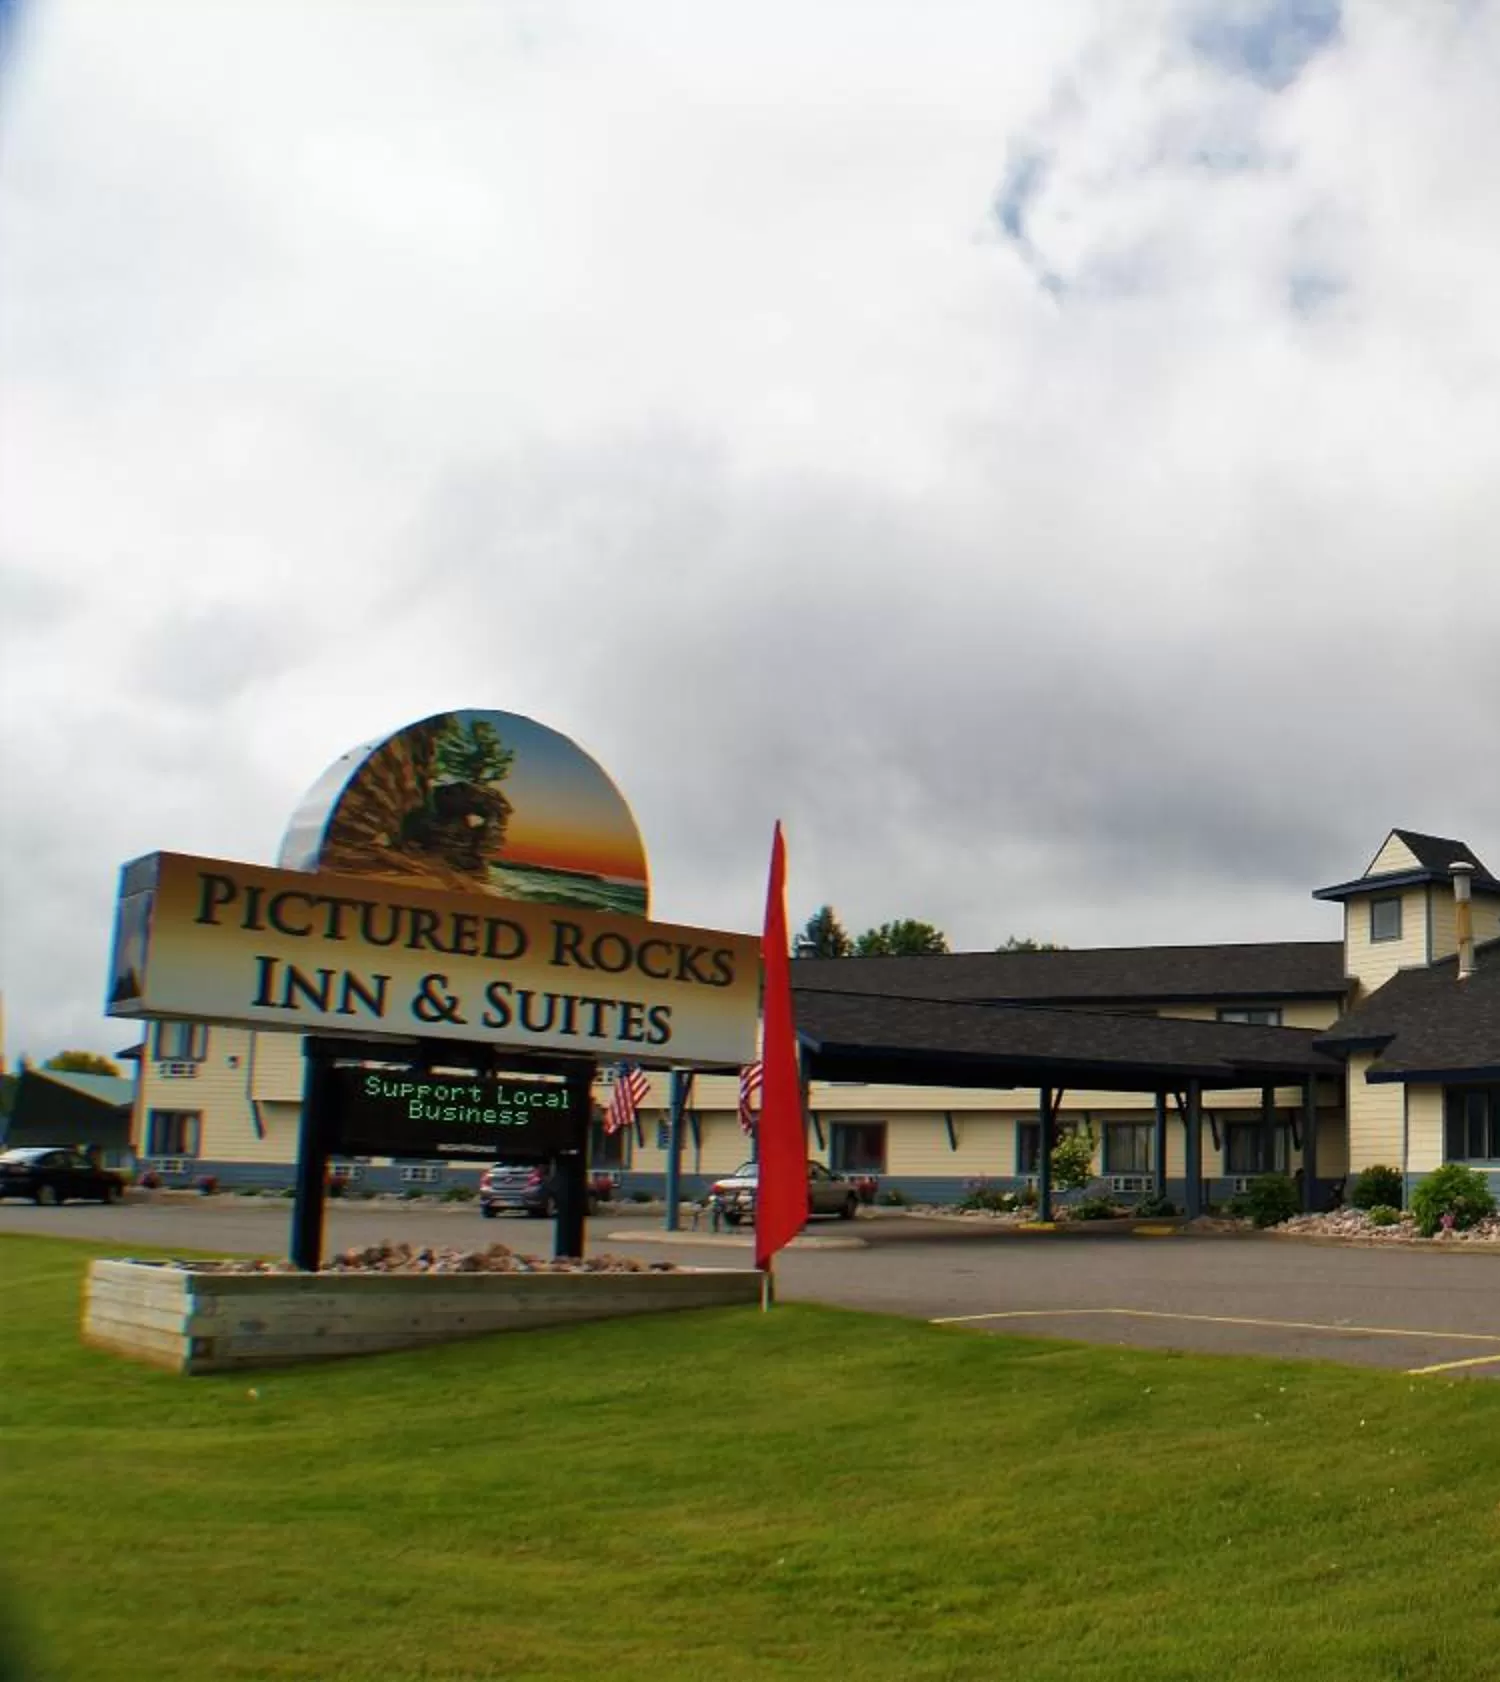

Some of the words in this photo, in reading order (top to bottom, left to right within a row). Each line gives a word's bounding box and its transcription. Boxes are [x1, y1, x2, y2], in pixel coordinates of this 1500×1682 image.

[194, 872, 528, 961] PICTURED
[550, 918, 736, 988] ROCKS
[252, 955, 391, 1018] INN
[412, 973, 468, 1026] &
[482, 980, 673, 1046] SUITES
[364, 1076, 482, 1103] Support
[497, 1085, 570, 1110] Local
[408, 1100, 530, 1126] Business
